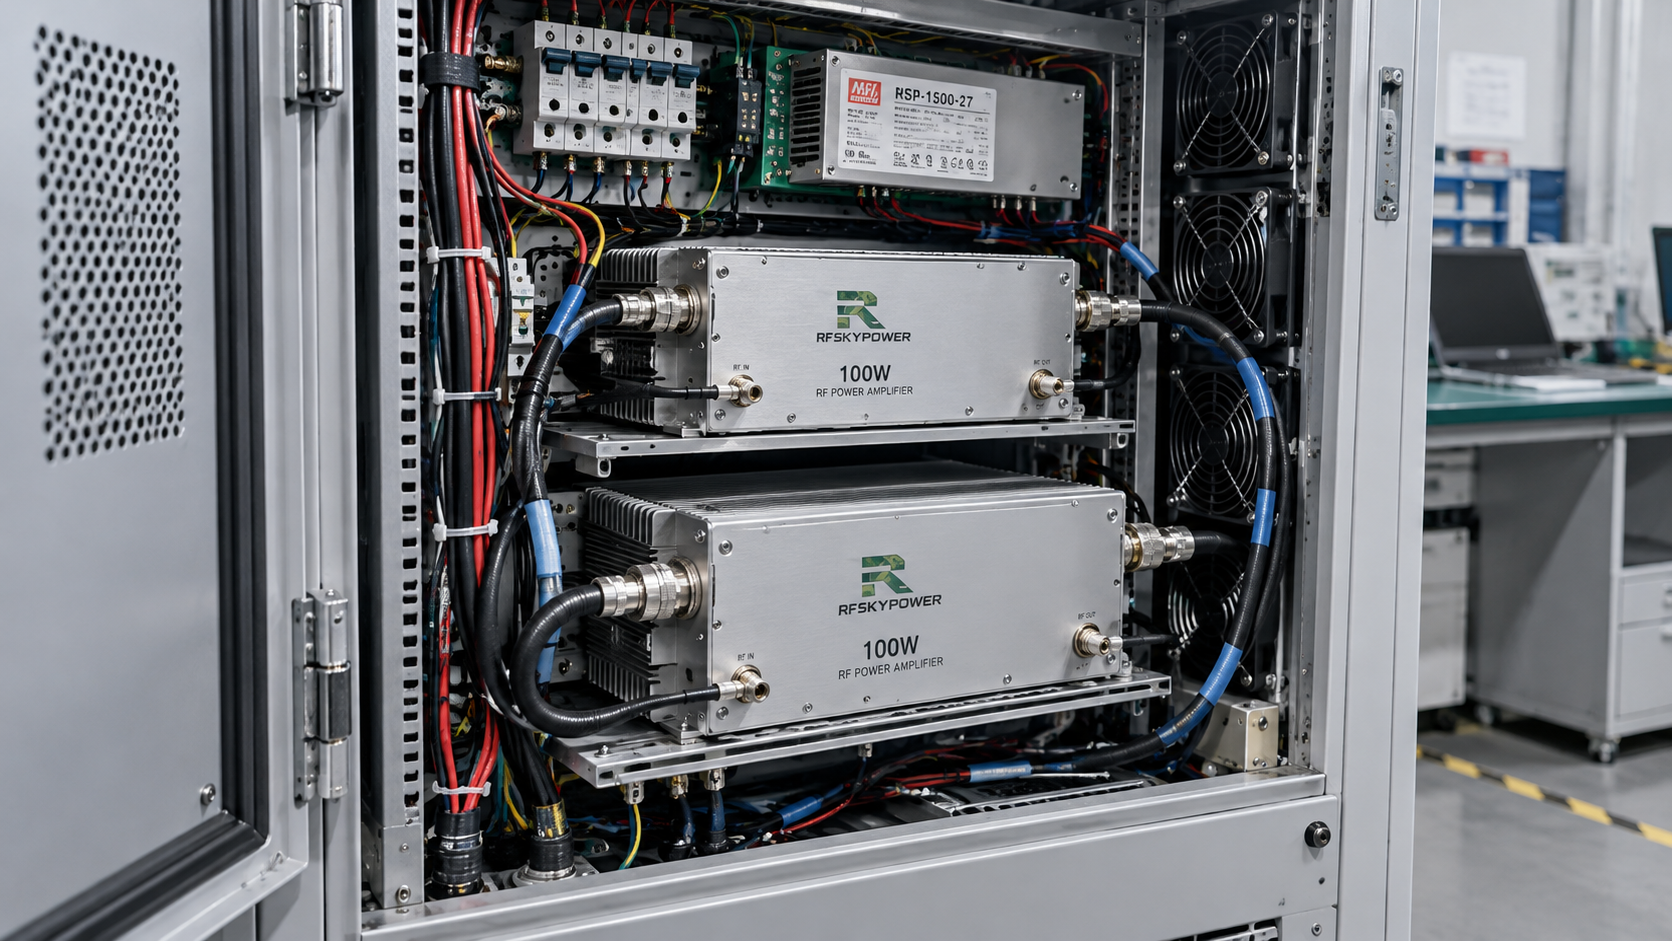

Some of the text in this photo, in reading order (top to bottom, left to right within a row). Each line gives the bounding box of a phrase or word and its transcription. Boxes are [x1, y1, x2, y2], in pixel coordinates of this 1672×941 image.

[895, 87, 974, 108] RSP-1500-27
[816, 332, 912, 342] RFSKYPOWER
[840, 364, 892, 382] 100W
[816, 386, 914, 398] RF POWER AMPLIFIER
[838, 594, 942, 616] RFSKYPOWER
[863, 635, 919, 660] 100W
[838, 656, 944, 680] RF POWER AMPLIFIER
